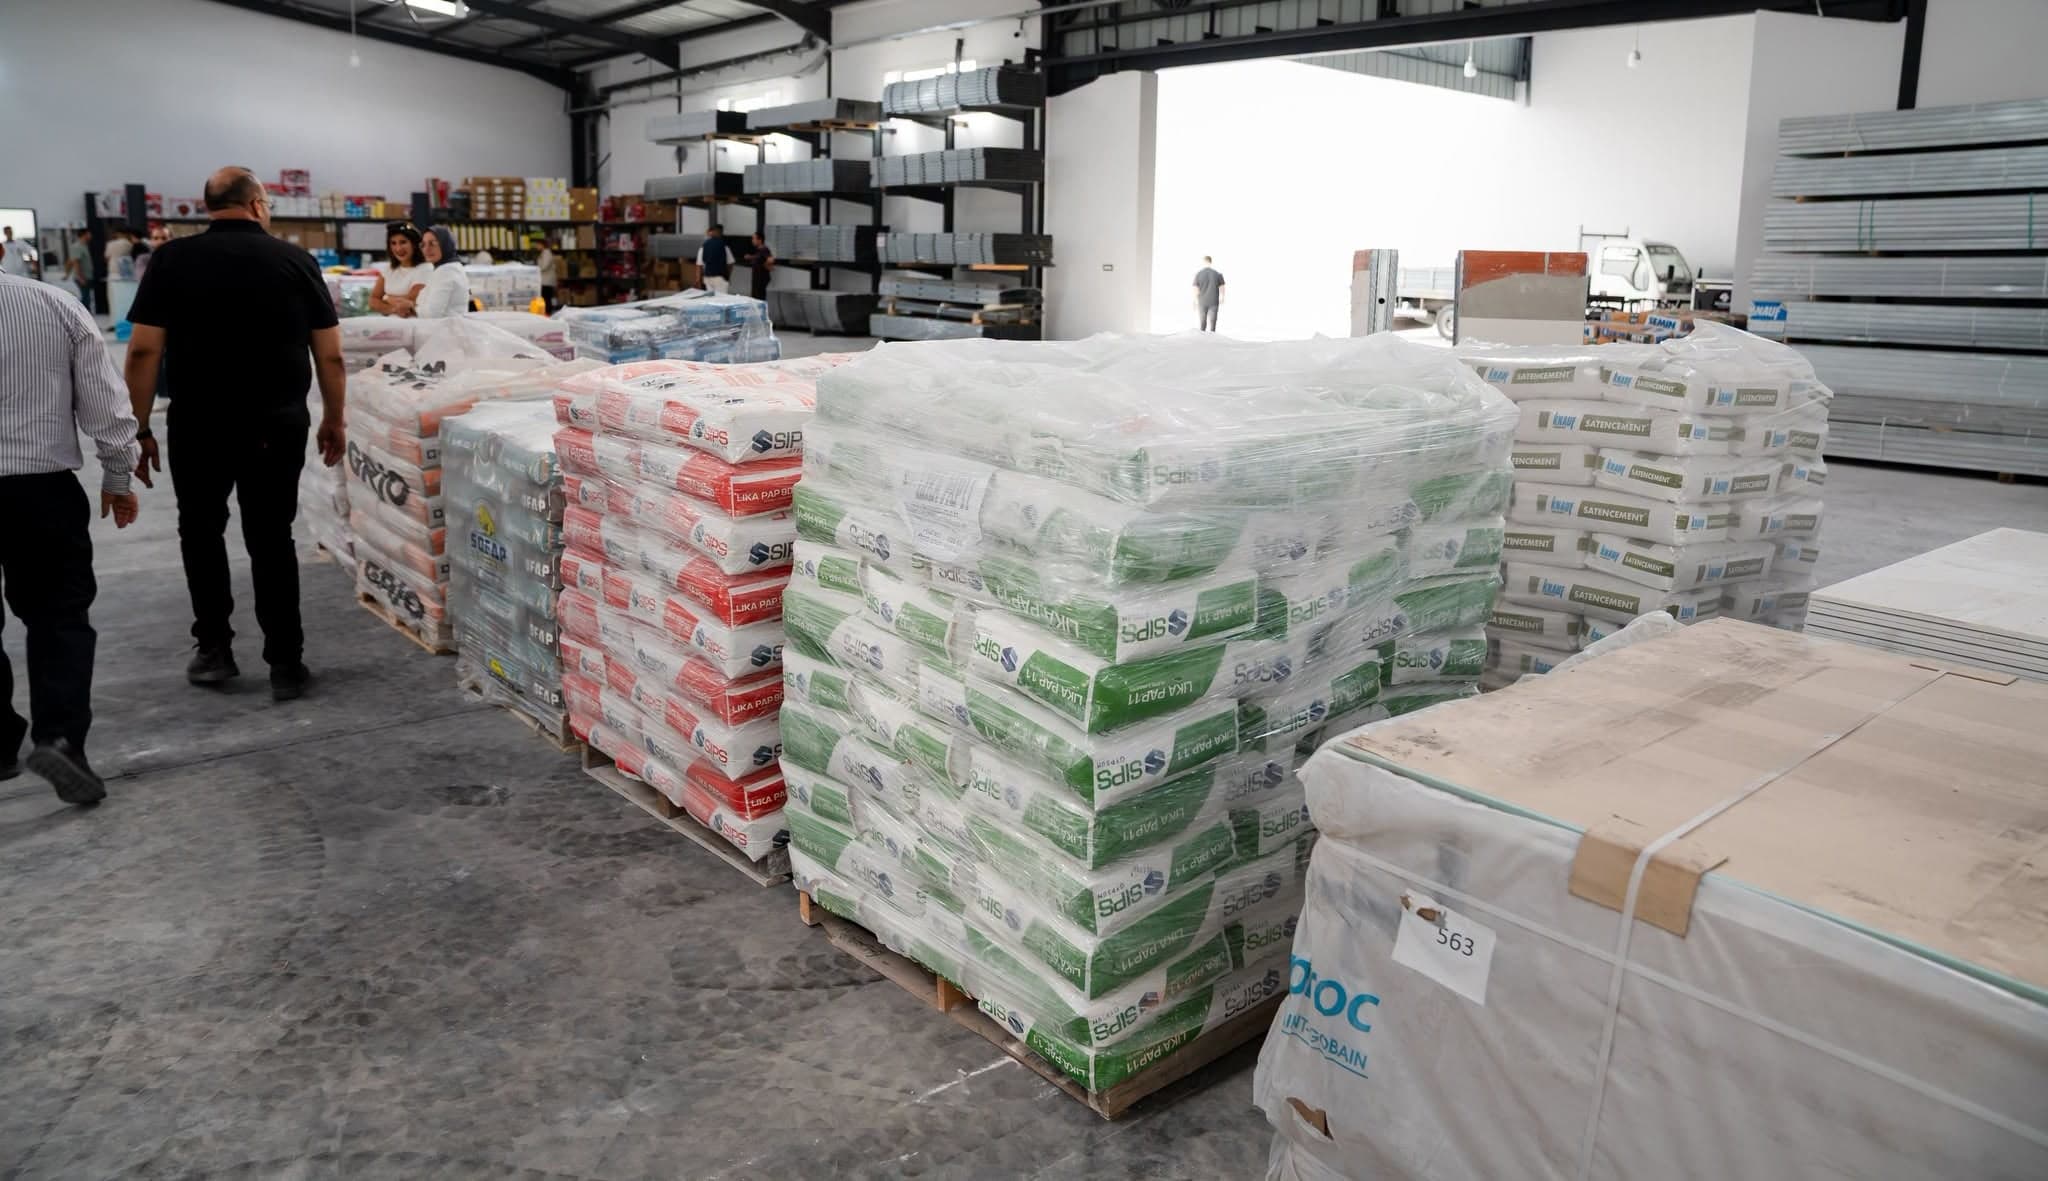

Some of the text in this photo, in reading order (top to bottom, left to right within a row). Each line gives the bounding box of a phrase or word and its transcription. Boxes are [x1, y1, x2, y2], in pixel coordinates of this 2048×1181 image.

[1648, 316, 1676, 329] SEMIN
[1517, 371, 1571, 381] SATENCEMENT
[1552, 411, 1647, 433] KNAUF SATENCEMENT
[774, 431, 802, 449] SIP
[1511, 456, 1557, 466] TENCEMENT
[736, 492, 759, 502] LIKA
[762, 489, 780, 500] PAP
[1584, 506, 1644, 522] SATENCEMENT
[704, 534, 728, 557] SIPS
[1503, 537, 1550, 548] ATENCEMENT
[736, 598, 778, 613] LIKA PAP
[1290, 599, 1326, 624] SIPS
[1574, 590, 1635, 610] SATENCEMENT
[1122, 617, 1166, 644] SIPS
[974, 634, 1000, 663] SIPS
[1025, 668, 1083, 706] LIKA PAP 11
[1128, 681, 1193, 707] LIKA PAP 11
[732, 702, 754, 713] LIKA
[755, 696, 773, 707] PAP
[704, 739, 728, 763] SIPS
[1177, 728, 1236, 761] LIKA PAP 11
[1096, 760, 1142, 790] SIPS
[722, 823, 747, 846] SIPS
[1122, 808, 1185, 841] LIKA PAP 11
[1263, 810, 1299, 838] SIPS
[1190, 852, 1210, 868] PAP
[1175, 866, 1187, 878] 11
[1099, 883, 1142, 918] SIPS
[1223, 883, 1264, 917] SIPS
[1247, 924, 1282, 950] SIPS
[1436, 928, 1475, 957] 563
[1121, 959, 1134, 972] 11
[1134, 945, 1159, 964] PAP
[1224, 982, 1264, 1018] SIPS
[1093, 1007, 1139, 1041] SIPS
[1126, 1031, 1187, 1073] LIKA PAP 11
[1285, 1013, 1368, 1070] INT-GOBAIN
[1067, 1061, 1088, 1078] LIKA
